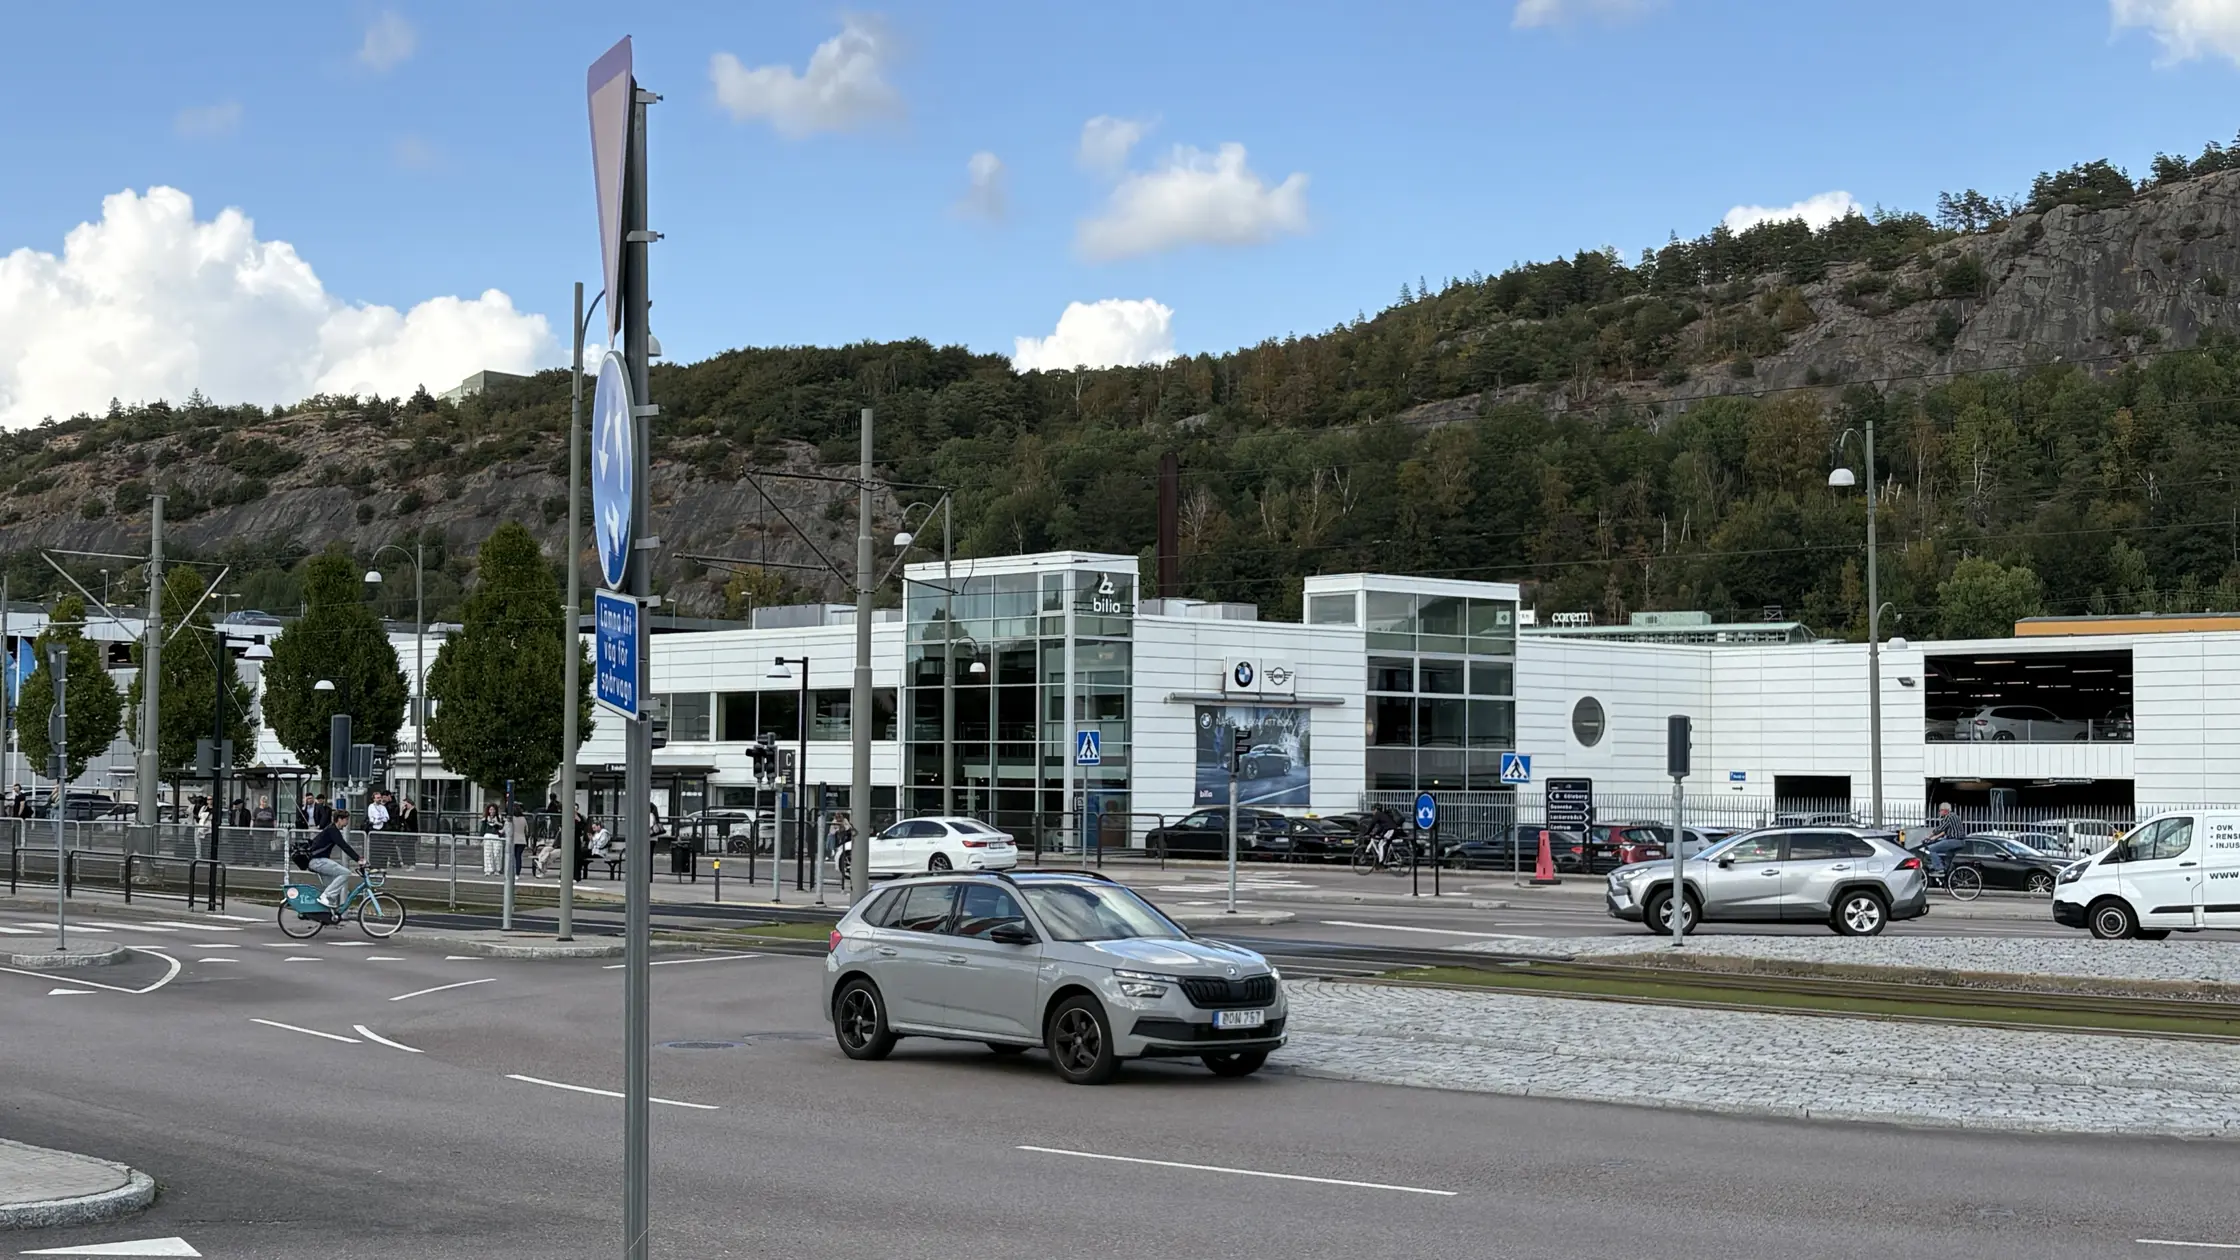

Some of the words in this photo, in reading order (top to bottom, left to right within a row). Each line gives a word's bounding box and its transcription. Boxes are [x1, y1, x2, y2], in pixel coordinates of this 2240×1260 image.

[600, 603, 621, 632] Lämna
[623, 608, 632, 636] fri
[1093, 597, 1121, 613] bilia
[1552, 612, 1589, 622] corem
[604, 636, 616, 669] väg
[618, 640, 628, 667] för
[601, 668, 632, 706] spårvagn
